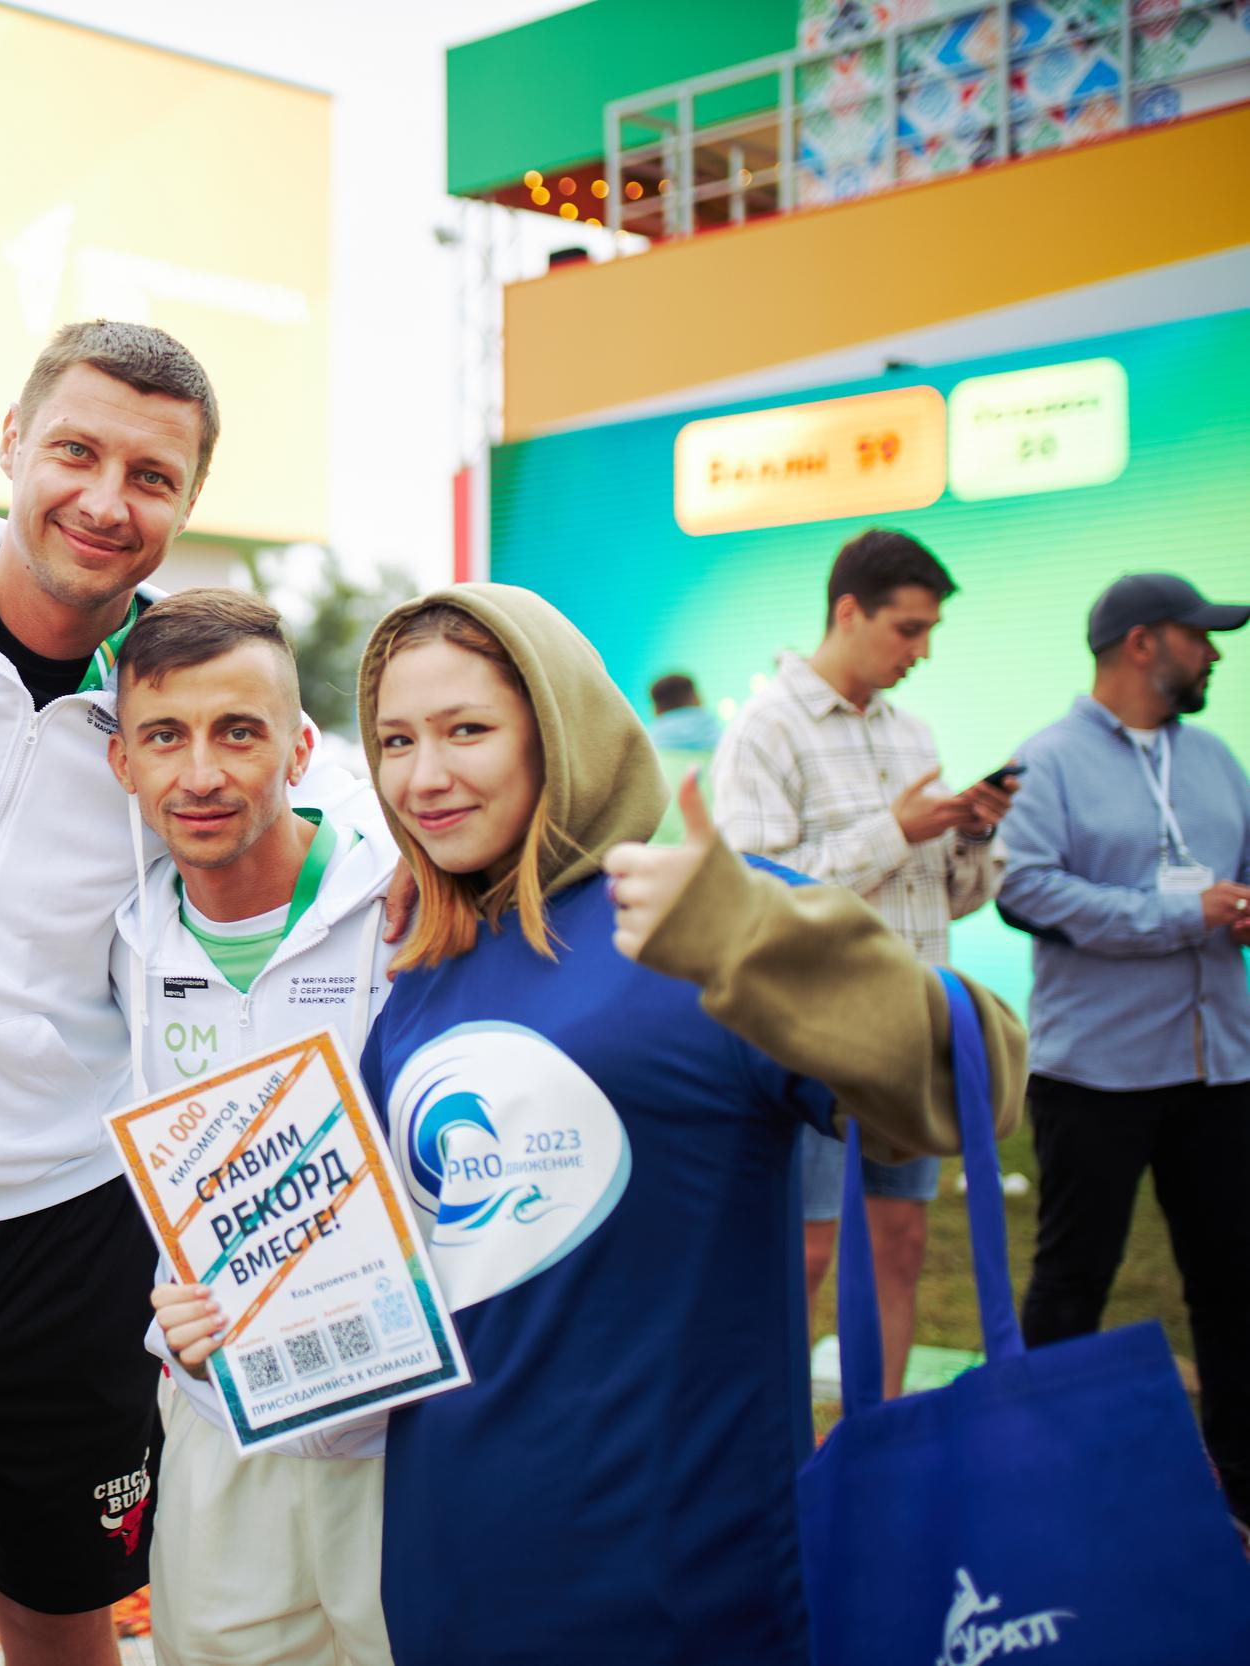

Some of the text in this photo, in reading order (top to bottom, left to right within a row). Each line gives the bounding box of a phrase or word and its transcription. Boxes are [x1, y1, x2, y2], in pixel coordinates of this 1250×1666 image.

[300, 986, 321, 995] СБЕР
[302, 976, 358, 984] MRIYA RESOR
[232, 1115, 250, 1135] ЗА
[249, 1103, 259, 1115] 4
[257, 1070, 286, 1107] ДНЯ!
[148, 1100, 207, 1171] 41 000
[168, 1100, 240, 1186] КИЛОМЕТРОВ
[524, 1128, 582, 1154] 2023
[195, 1124, 306, 1204] СТАВИМ
[210, 1148, 353, 1250] РЕКОРД
[229, 1204, 342, 1286] ВМЕСТЕ!
[290, 1290, 313, 1300] Код
[251, 1373, 356, 1418] ПРИСОЕДИНЯЙСЯ
[357, 1370, 365, 1382] К
[94, 1470, 142, 1500] CHIC
